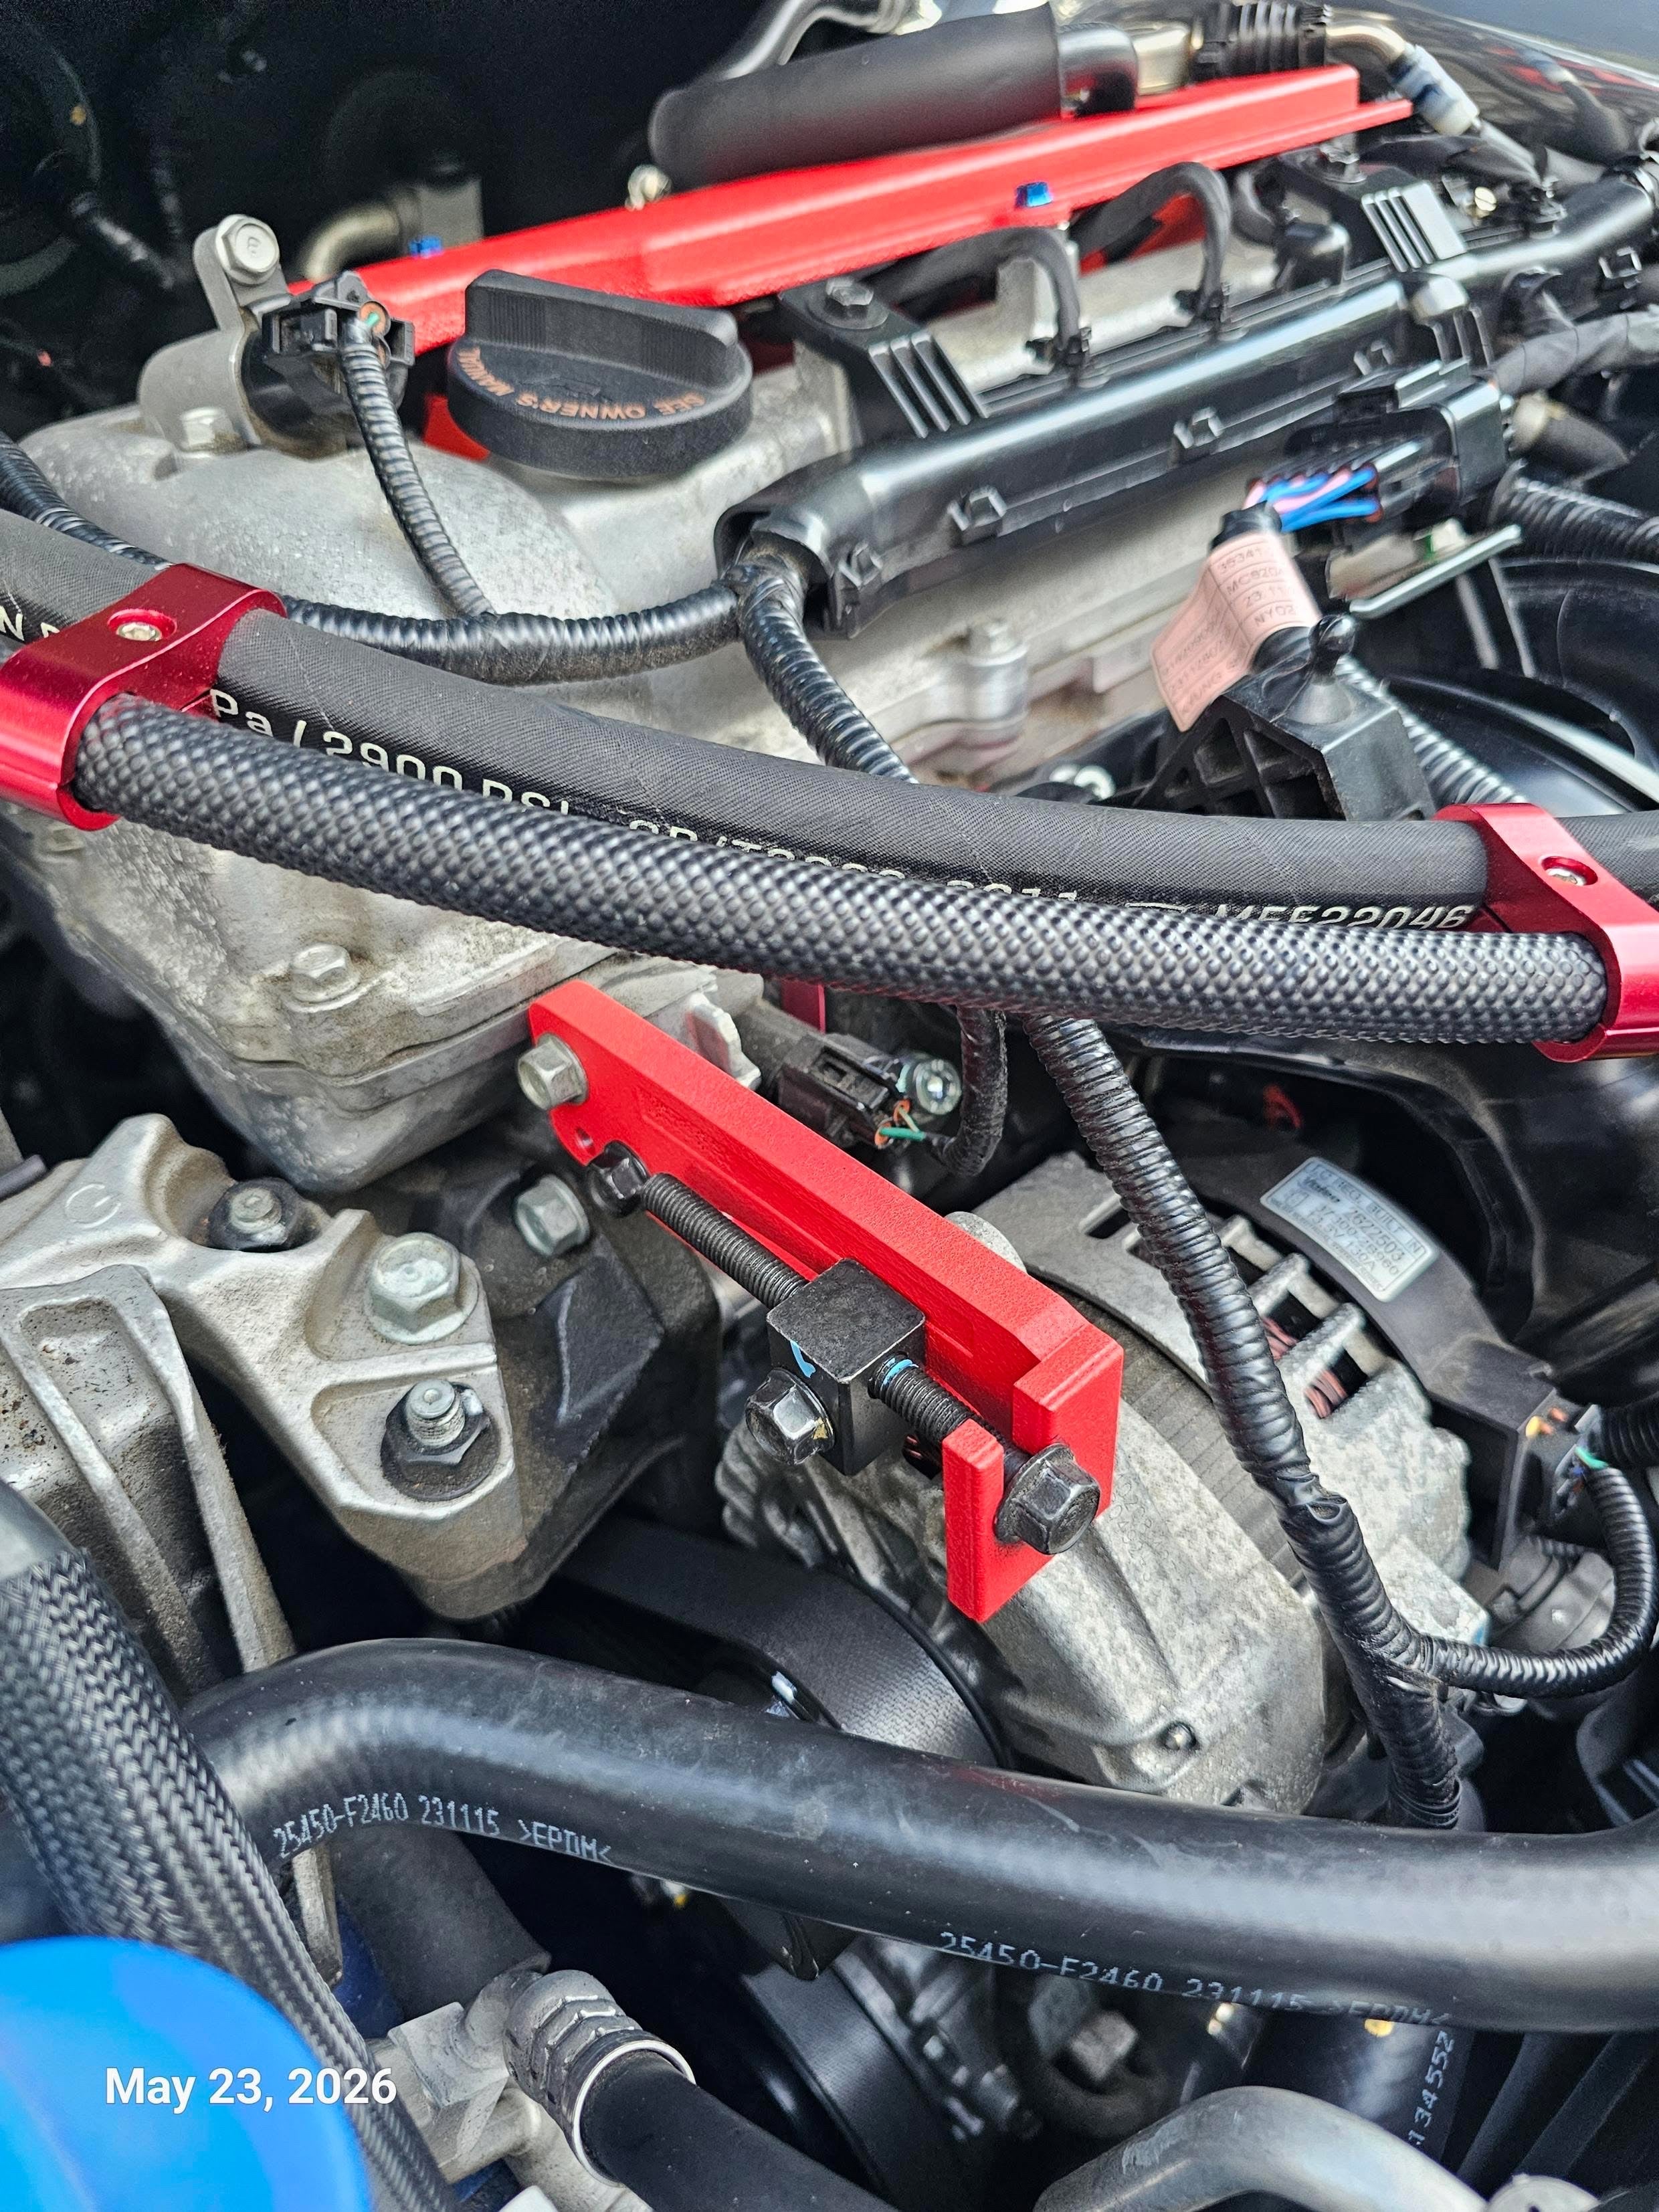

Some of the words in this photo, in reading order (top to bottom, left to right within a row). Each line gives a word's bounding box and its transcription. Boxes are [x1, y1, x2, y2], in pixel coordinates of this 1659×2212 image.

[456, 346, 514, 397] MANUAL
[517, 392, 647, 419] OWNER'S
[654, 392, 706, 415] SEE
[273, 1792, 409, 1859] 25450-F2460
[417, 1795, 500, 1836] 231115
[940, 1932, 1163, 1992] 25450-F2460
